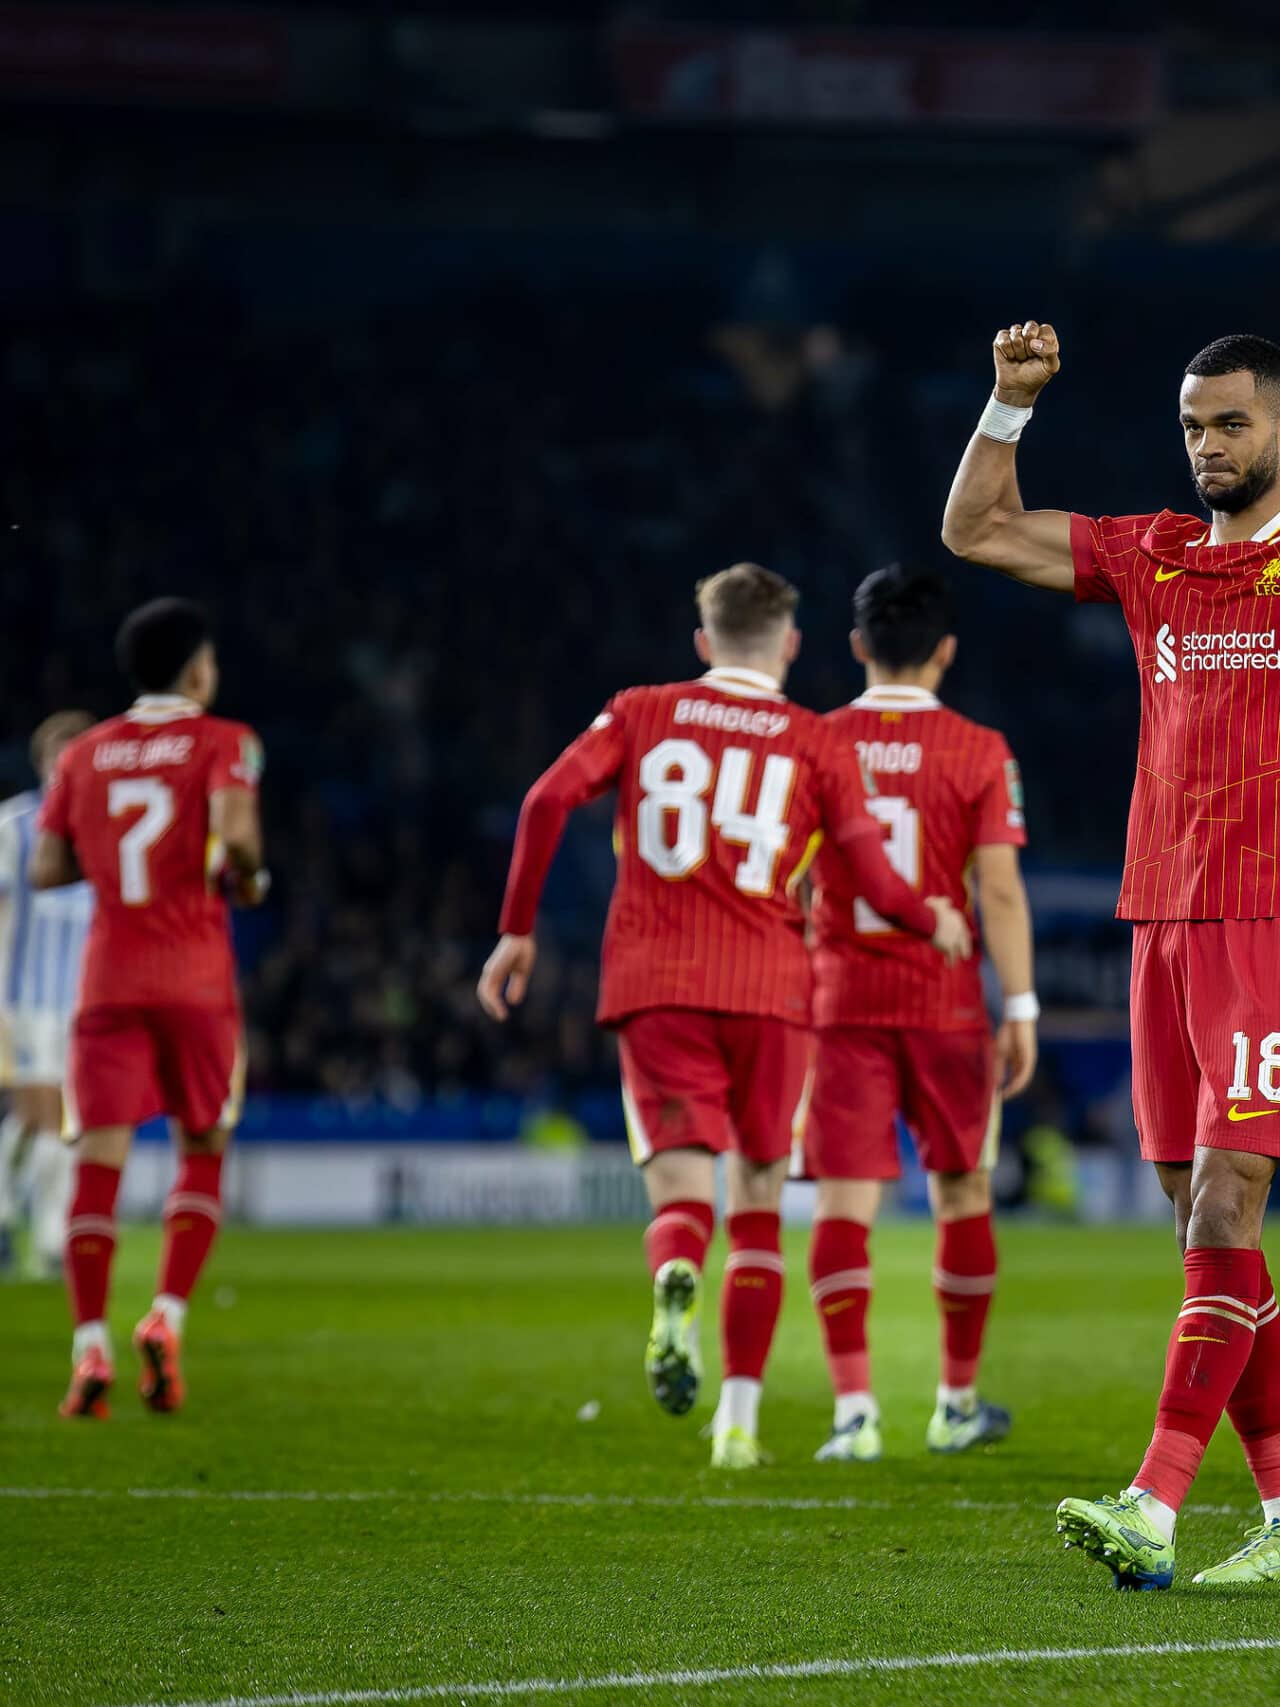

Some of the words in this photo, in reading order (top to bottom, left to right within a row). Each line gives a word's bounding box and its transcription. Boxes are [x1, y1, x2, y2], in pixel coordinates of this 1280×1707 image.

[1182, 629, 1275, 650] standard
[673, 699, 790, 738] BRADLEY
[108, 776, 175, 906] 7
[638, 738, 795, 898] 84
